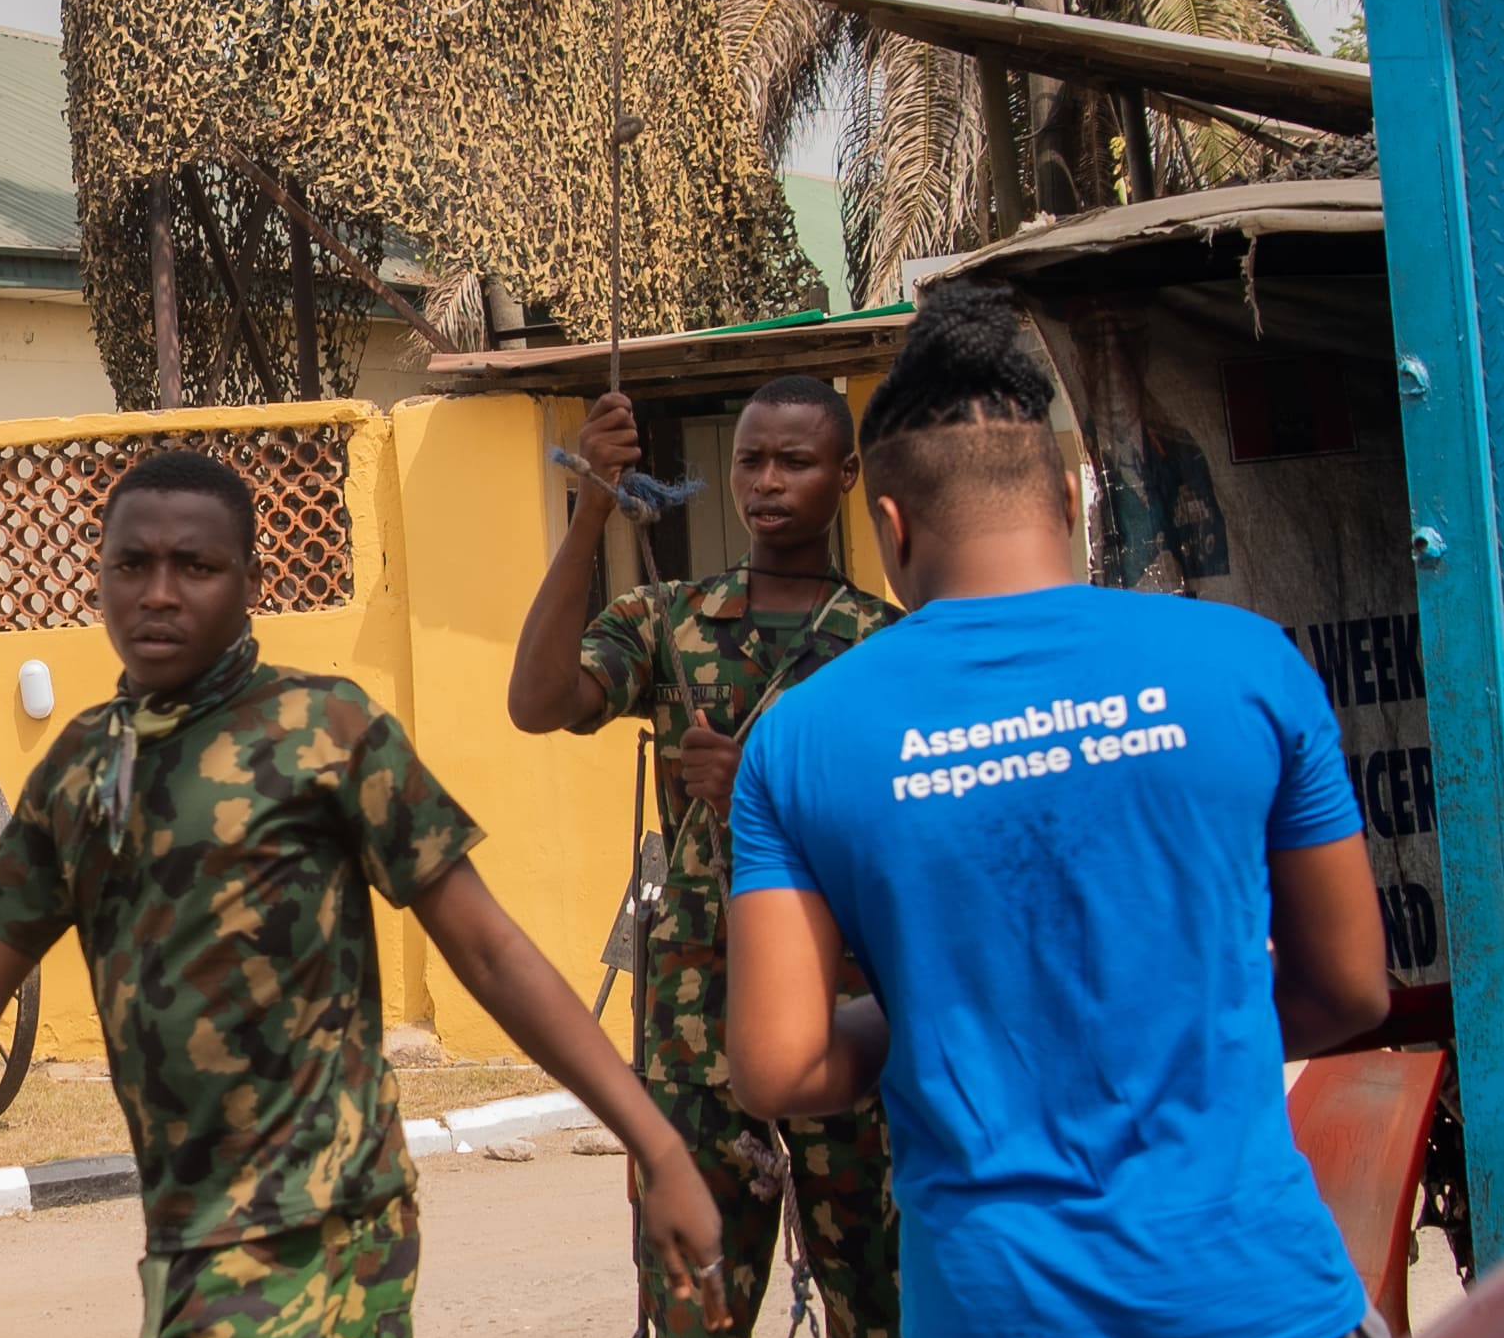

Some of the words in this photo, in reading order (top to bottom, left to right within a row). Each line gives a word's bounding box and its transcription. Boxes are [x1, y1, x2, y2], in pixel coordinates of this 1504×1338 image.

[900, 695, 1127, 761] Assembling
[1137, 686, 1168, 713] a
[892, 746, 1071, 802] response
[1080, 723, 1187, 765] team
